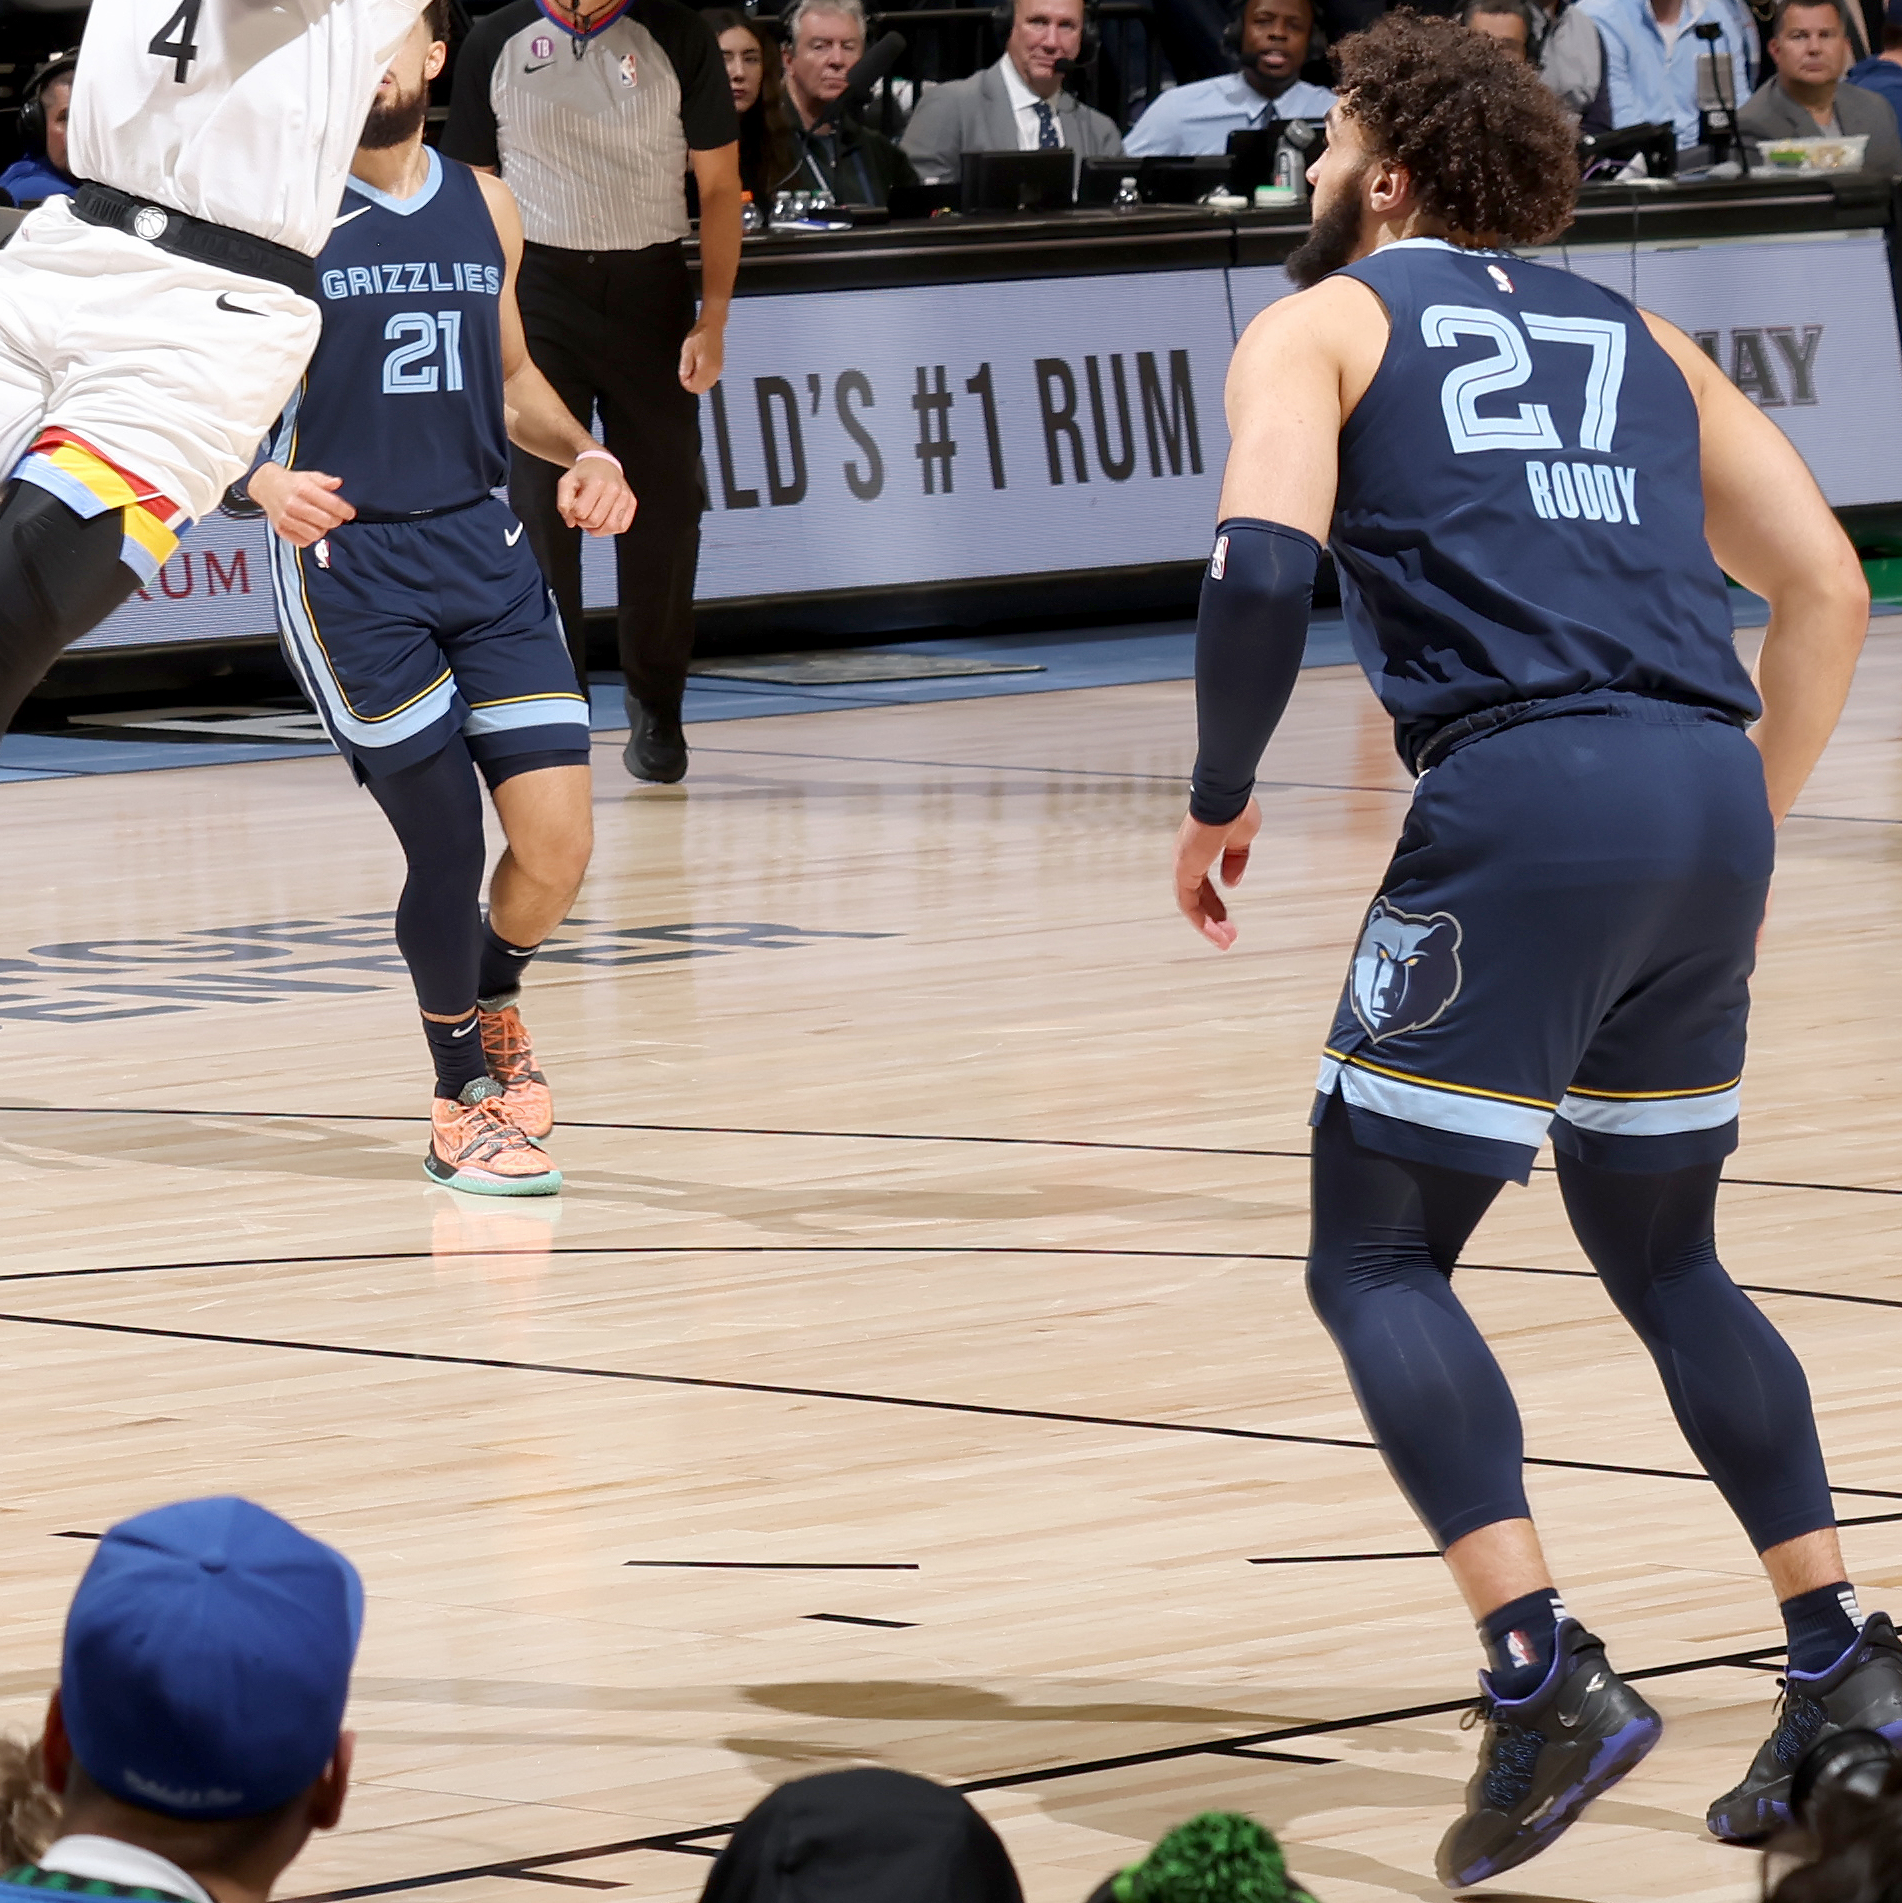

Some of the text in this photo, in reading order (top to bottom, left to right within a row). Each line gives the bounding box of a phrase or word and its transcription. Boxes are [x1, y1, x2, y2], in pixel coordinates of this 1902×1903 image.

[321, 262, 501, 301] GRIZZLIES
[382, 310, 464, 395] 21
[1421, 304, 1627, 455] 27
[698, 349, 1204, 512] LD'S #1 RUM
[1525, 460, 1641, 526] RODDY
[140, 548, 251, 602] UM
